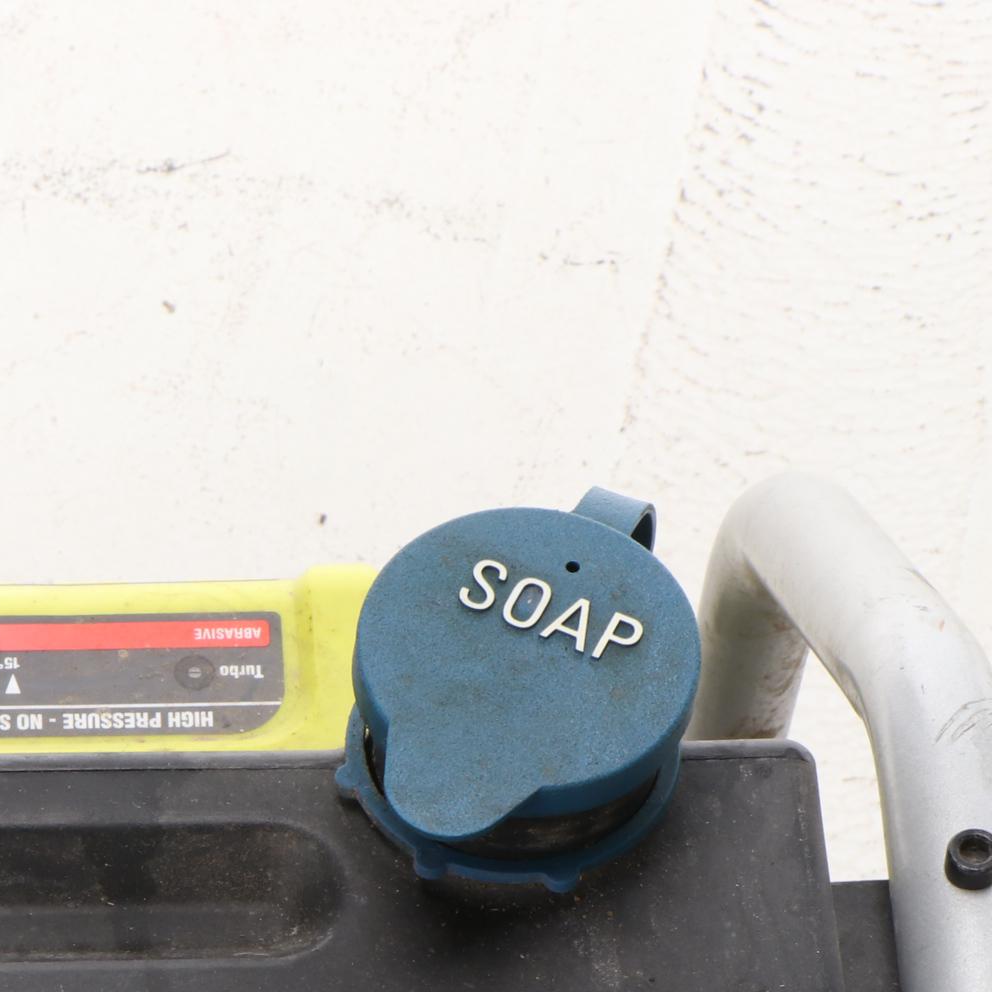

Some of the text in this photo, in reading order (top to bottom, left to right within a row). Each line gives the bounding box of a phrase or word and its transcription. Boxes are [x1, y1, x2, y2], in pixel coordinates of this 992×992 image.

[459, 559, 644, 660] SOAP
[194, 627, 262, 640] ABRASIVE
[219, 664, 264, 679] Turbo
[16, 713, 42, 729] NO
[63, 712, 161, 728] PRESSURE
[168, 711, 214, 728] HIGH
